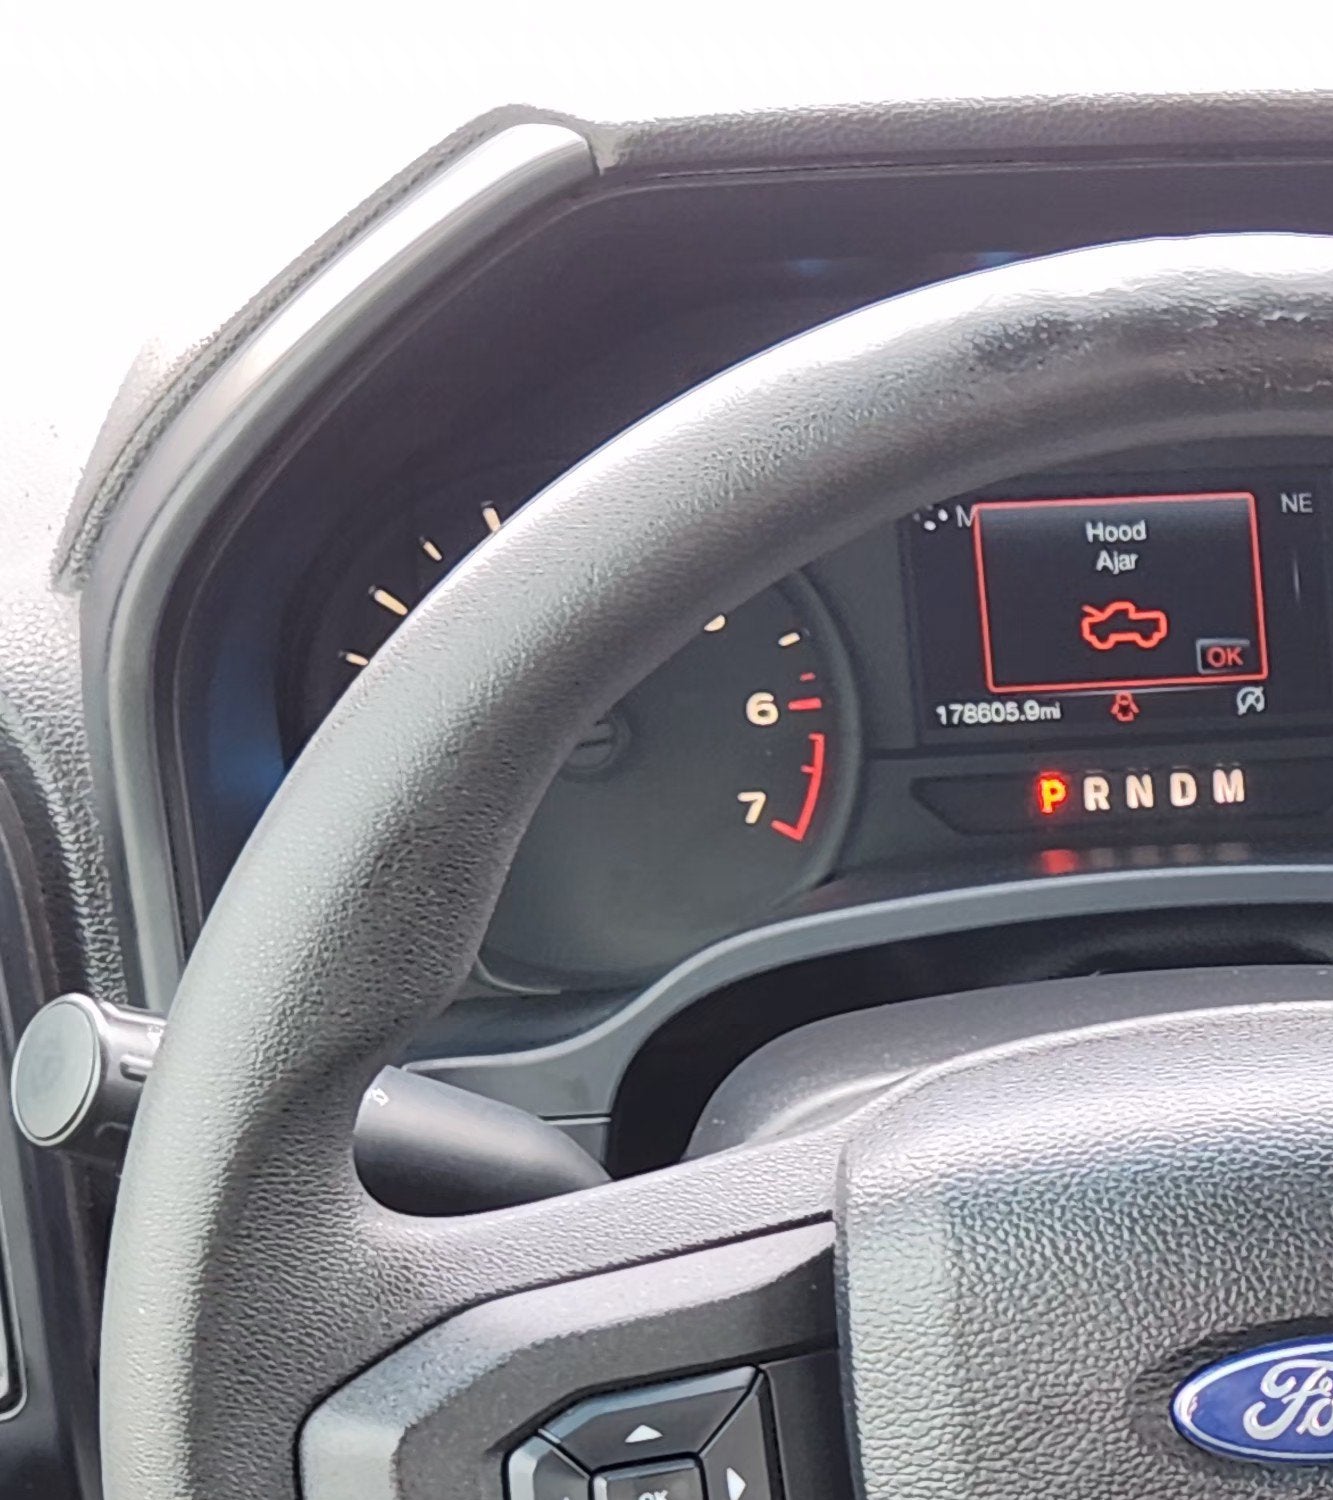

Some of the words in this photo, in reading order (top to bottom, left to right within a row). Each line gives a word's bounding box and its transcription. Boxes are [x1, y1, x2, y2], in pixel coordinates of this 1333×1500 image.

[1281, 493, 1313, 513] NE
[1086, 521, 1147, 543] Hood
[1096, 552, 1138, 574] Ajar
[1206, 646, 1244, 668] OK
[745, 691, 779, 726] 6
[1039, 777, 1067, 813] P
[1083, 774, 1111, 811] R
[1126, 774, 1154, 809] N
[1170, 772, 1197, 807] D
[1213, 768, 1245, 803] M
[737, 791, 766, 824] 7
